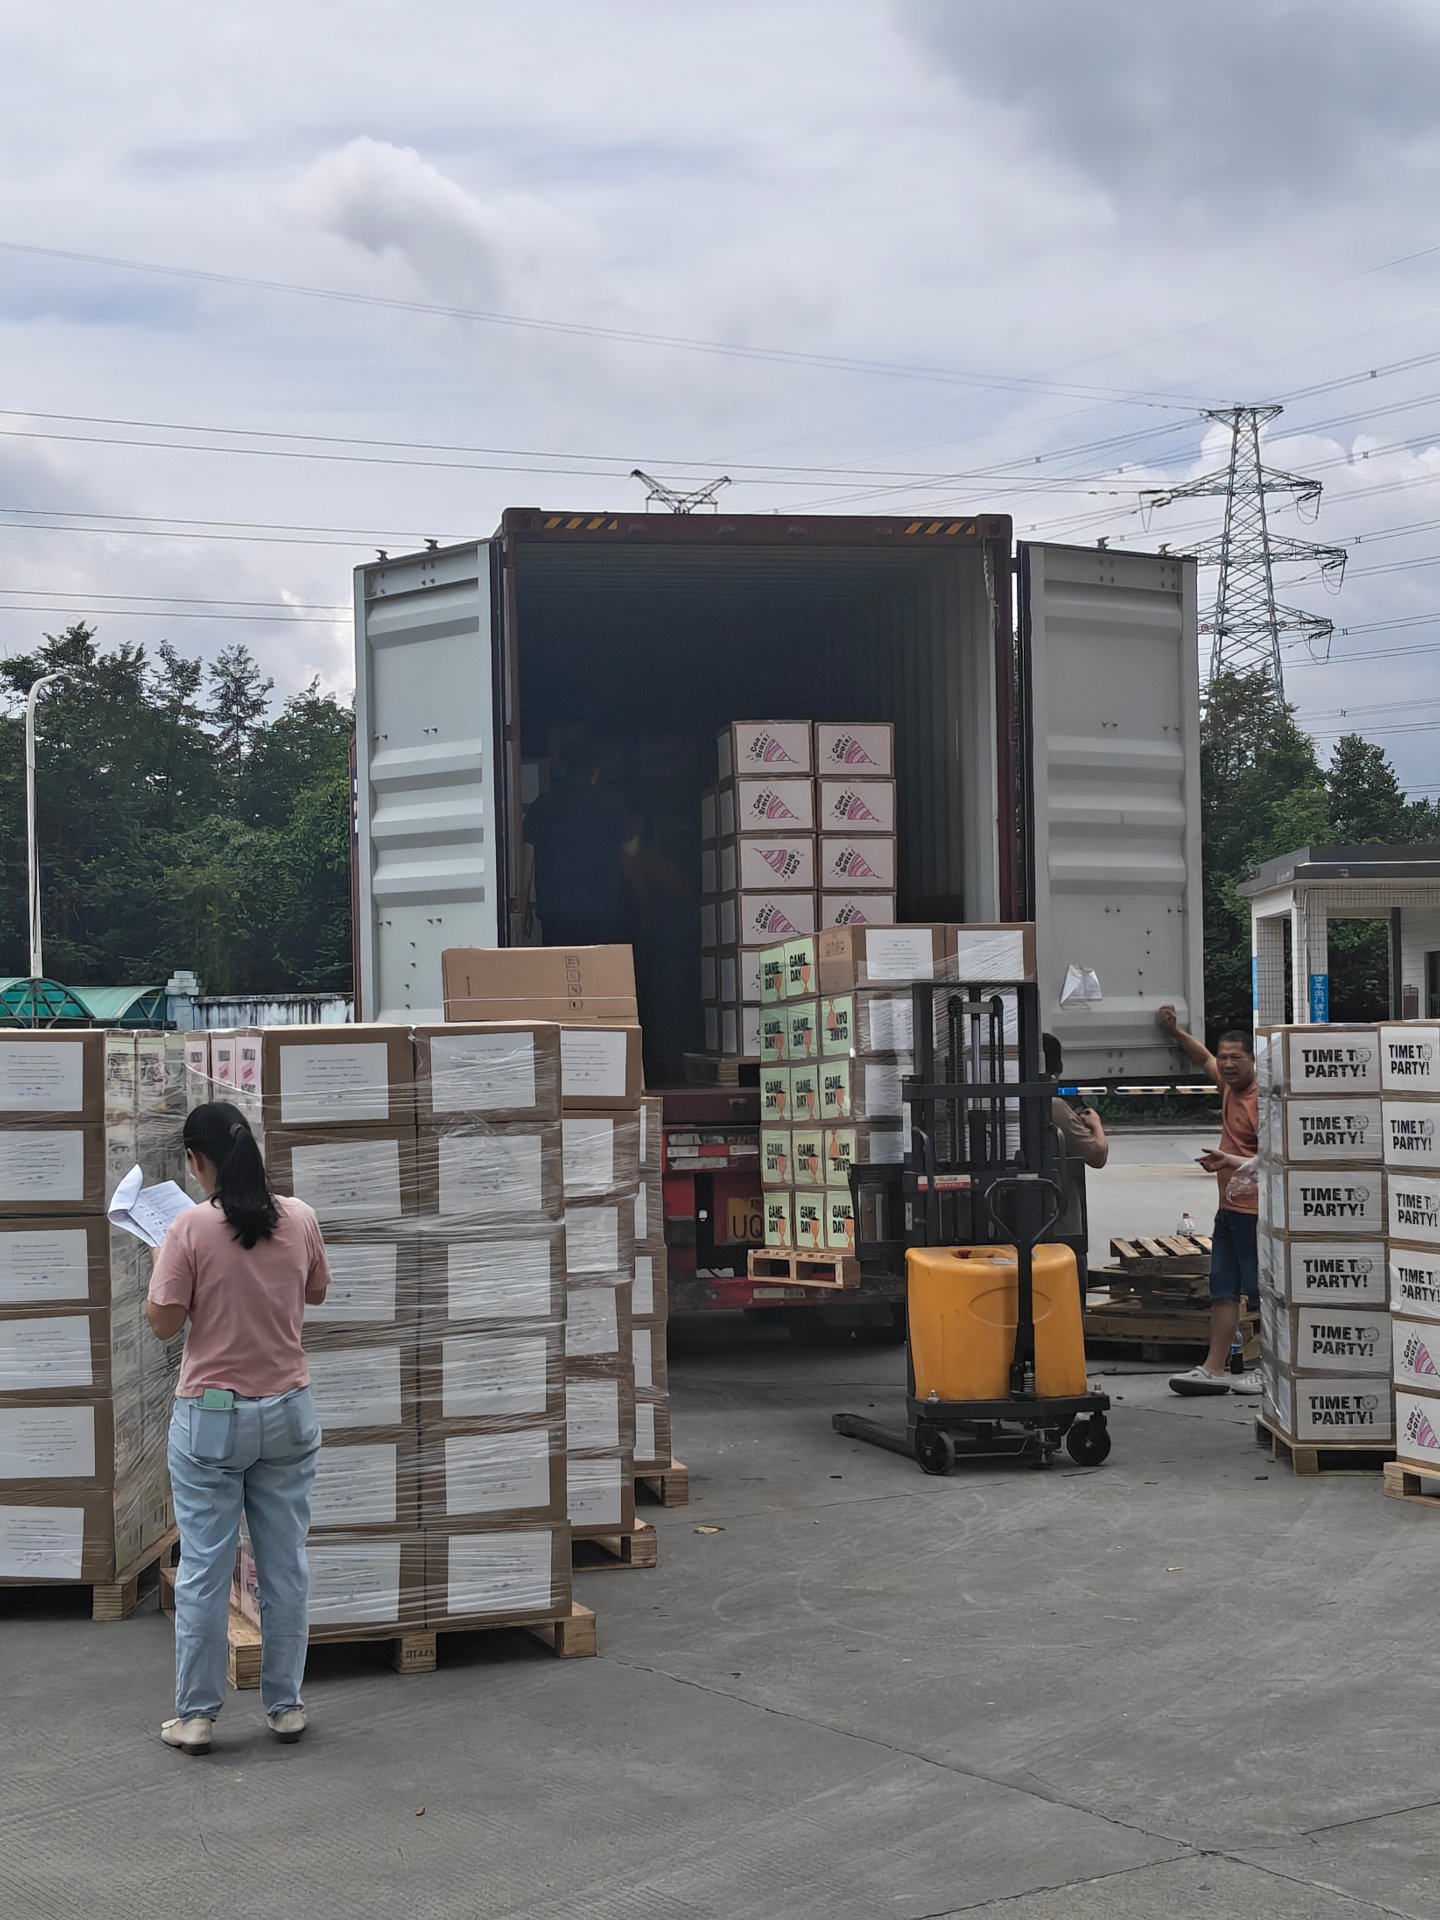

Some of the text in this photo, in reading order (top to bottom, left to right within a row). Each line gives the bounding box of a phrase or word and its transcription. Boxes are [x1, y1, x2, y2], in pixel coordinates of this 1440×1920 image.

[750, 737, 760, 753] Con
[832, 738, 842, 754] Con
[753, 793, 763, 809] Con
[834, 794, 846, 811] Con
[835, 852, 846, 868] Con
[755, 908, 766, 924] Con
[1302, 1049, 1342, 1062] TIME
[1389, 1044, 1414, 1059] TIME
[1305, 1064, 1366, 1078] PARTY!
[1391, 1061, 1430, 1076] PARTY!
[1300, 1116, 1341, 1130] TIME
[1391, 1120, 1416, 1134] TIME
[1303, 1131, 1364, 1145] PARTY!
[1393, 1137, 1432, 1151] PARTY!
[1301, 1188, 1342, 1201] TIME
[1396, 1193, 1424, 1209] TIME
[1303, 1204, 1364, 1216] PARTY!
[1398, 1209, 1438, 1227] PARTY!
[1303, 1259, 1344, 1272] TIME
[1306, 1275, 1368, 1288] PARTY!
[1398, 1267, 1425, 1285] TIME
[1310, 1325, 1352, 1340] TIME
[1313, 1341, 1374, 1356] PARTY!
[1403, 1339, 1413, 1358] Con
[1309, 1396, 1350, 1409] TIME
[1312, 1412, 1373, 1425] PARTY!
[1406, 1412, 1416, 1431] Con
